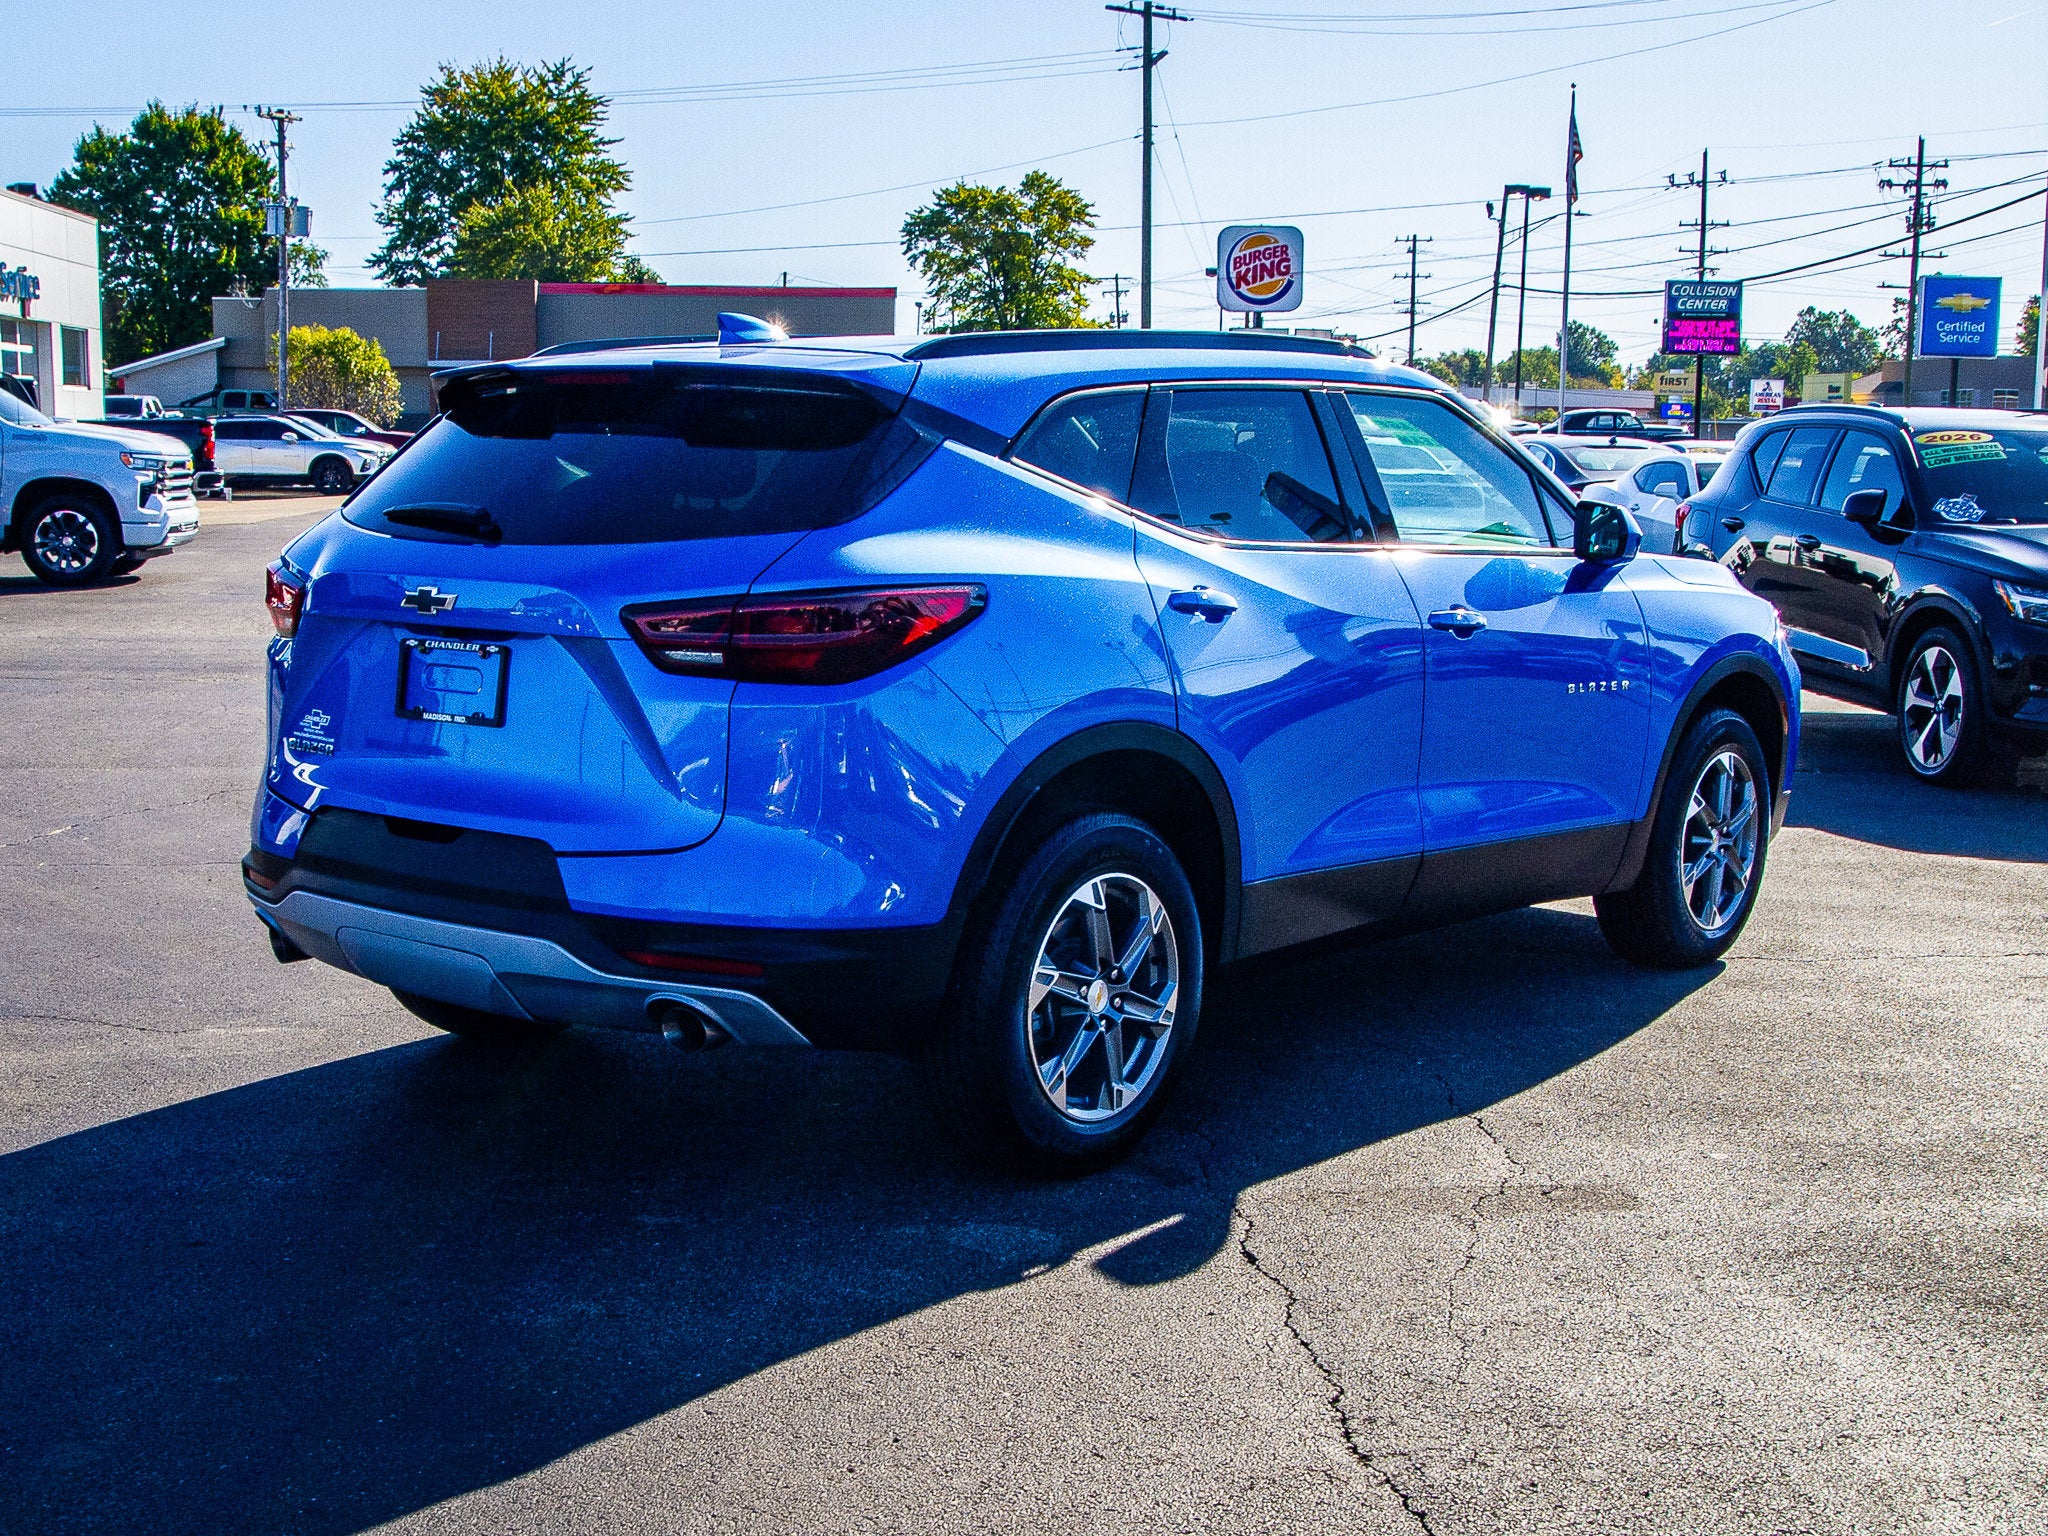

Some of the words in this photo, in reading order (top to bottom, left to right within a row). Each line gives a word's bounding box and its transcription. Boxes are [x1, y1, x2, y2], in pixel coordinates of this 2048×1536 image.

[1233, 244, 1289, 271] BURGER
[1235, 257, 1291, 290] KING
[1671, 284, 1738, 297] COLLISION
[1677, 297, 1728, 310] CENTER
[1936, 320, 1986, 333] Certified
[1939, 332, 1980, 344] Service
[1924, 433, 1981, 443] 2026
[1924, 448, 1940, 457] ALL
[1940, 444, 1972, 454] WHEEL
[1927, 457, 1951, 466] LOW
[1953, 451, 2003, 462] MILEAGE
[425, 640, 480, 651] CHANDLER
[1568, 680, 1630, 694] BLAZER
